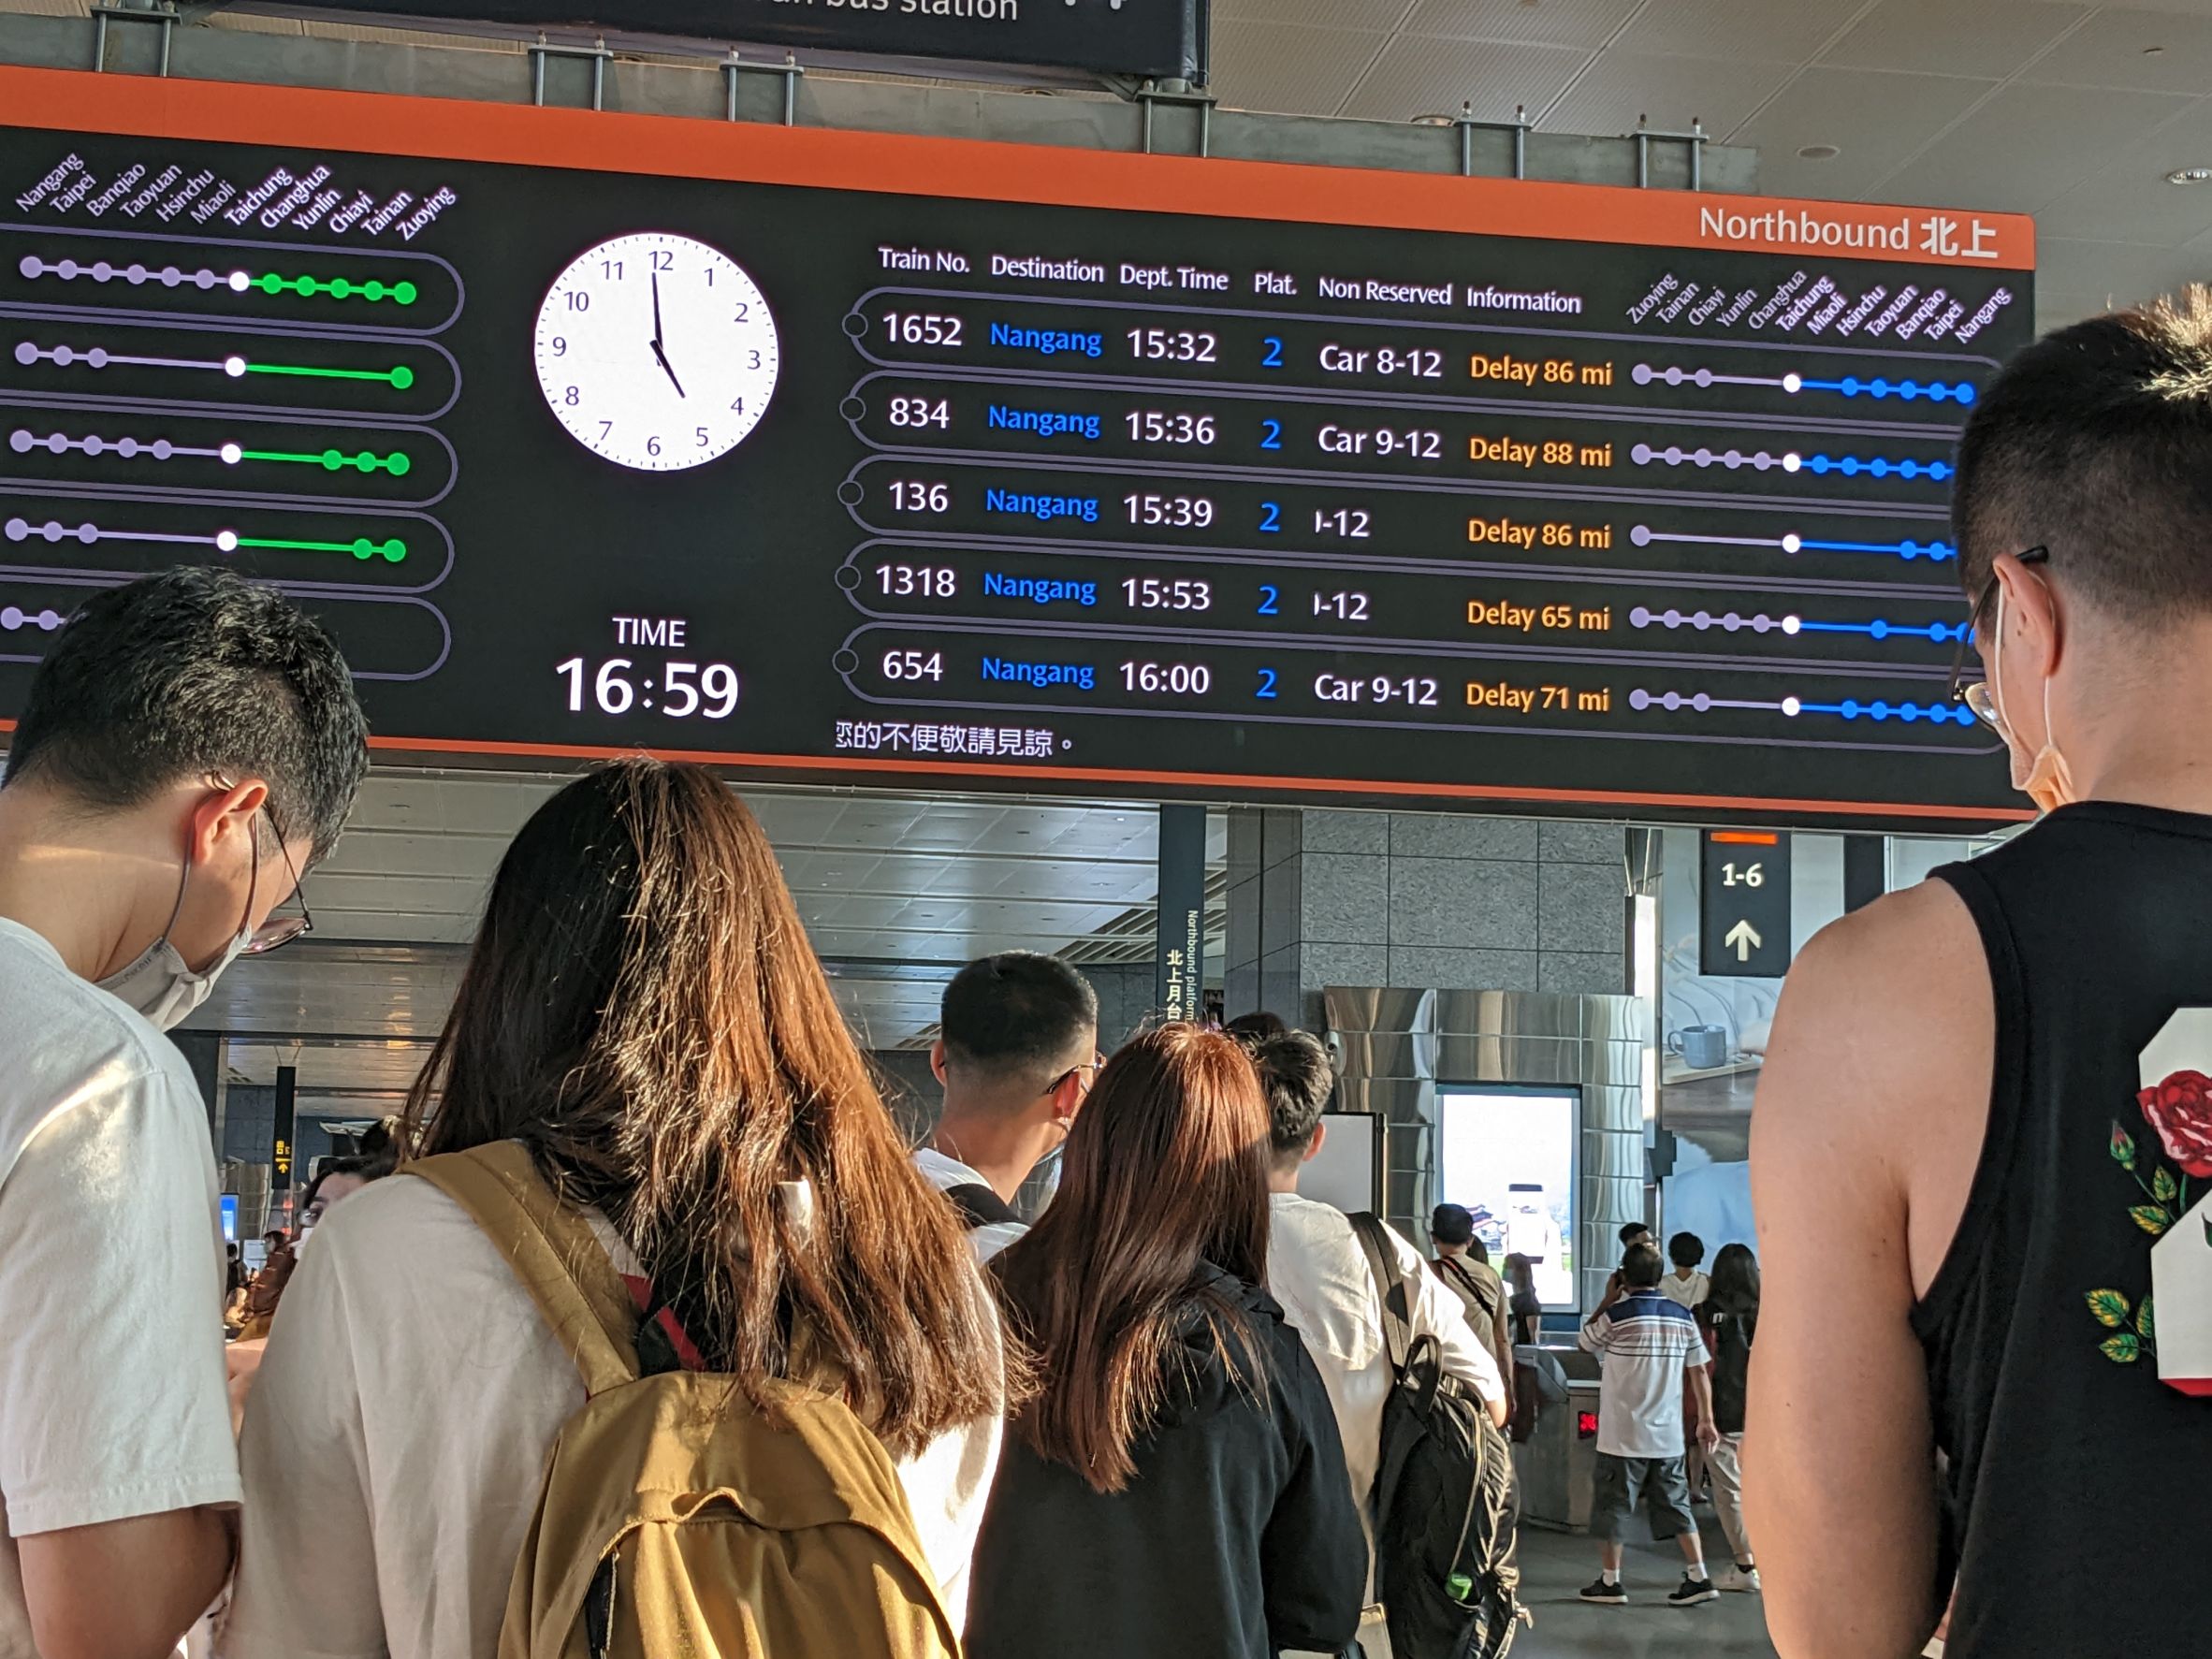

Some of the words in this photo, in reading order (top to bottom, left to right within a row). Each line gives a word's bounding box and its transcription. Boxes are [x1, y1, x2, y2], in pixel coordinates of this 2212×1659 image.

[900, 0, 1018, 21] station
[15, 153, 84, 212] Nangang
[49, 170, 96, 213] Taipei
[86, 164, 147, 217] Banqiao
[119, 164, 183, 218] Taoyuan
[155, 168, 215, 223] Hsinchu
[224, 167, 294, 226] Taichung
[260, 165, 331, 229] Changhua
[190, 179, 237, 225] Miaoli
[291, 188, 342, 231] Yunlin
[329, 189, 374, 234] Chiayi
[360, 191, 414, 236] Tainan
[395, 186, 457, 241] Zuoying
[1700, 207, 1910, 251] Northbound
[1920, 216, 1999, 259] 北上
[602, 261, 622, 280] 11
[650, 252, 673, 270] 12
[879, 247, 930, 270] Train
[937, 252, 969, 272] No.
[992, 255, 1104, 282] Destination
[706, 269, 712, 286] 1
[1121, 265, 1172, 289] Dept.
[1177, 268, 1229, 290] Time
[1255, 272, 1297, 295] Plat.
[1319, 278, 1361, 298] Non
[1366, 281, 1452, 305] Reserved
[565, 292, 589, 311] 10
[735, 303, 748, 322] 2
[1468, 286, 1581, 313] Information
[1625, 273, 1679, 325] Zuoying
[1655, 283, 1700, 324] Tainan
[1688, 285, 1725, 327] Chiayi
[1715, 289, 1757, 327] Yunlin
[1749, 270, 1807, 329] Changhua
[1775, 275, 1835, 331] Taichung
[1807, 291, 1847, 335] Miaoli
[1836, 285, 1886, 337] Hsinchu
[1864, 285, 1917, 337] Taoyuan
[883, 313, 962, 345] 1652
[1895, 289, 1946, 341] Banqiao
[1924, 299, 1964, 341] Taipei
[1955, 287, 2012, 344] Nangang
[553, 337, 566, 357] 9
[991, 323, 1101, 357] Nangang
[1128, 329, 1215, 362] 15:32
[1262, 338, 1282, 366] 2
[749, 351, 760, 369] 3
[1320, 345, 1369, 372] Car
[1377, 349, 1441, 377] 8-12
[1472, 356, 1538, 386] Delay
[1544, 360, 1575, 383] 86
[1582, 362, 1611, 386] mi
[566, 386, 578, 405] 8
[731, 398, 743, 415] 4
[890, 398, 949, 429] 834
[989, 405, 1100, 438] Nangang
[1126, 413, 1215, 444] 15:36
[600, 421, 612, 440] 7
[697, 428, 707, 446] 5
[1260, 419, 1281, 449] 2
[1318, 426, 1367, 453] Car
[1376, 429, 1440, 458] 9-12
[648, 437, 661, 456] 6
[1471, 437, 1536, 467] Delay
[1543, 443, 1573, 464] 88
[1581, 444, 1610, 466] mi
[890, 482, 948, 512] 136
[987, 489, 1098, 521] Nangang
[1124, 495, 1212, 527] 15:39
[1259, 502, 1280, 531] 2
[1469, 518, 1536, 549] Delay
[1542, 524, 1573, 546] 86
[1580, 525, 1610, 548] mi
[877, 565, 955, 597] 1318
[985, 573, 1096, 605] Nangang
[1122, 579, 1210, 610] 15:53
[1258, 586, 1278, 614] 2
[1468, 601, 1535, 632] Delay
[1542, 606, 1572, 628] 65
[1579, 607, 1609, 630] mi
[612, 618, 686, 647] TIME
[883, 651, 942, 681] 654
[982, 658, 1095, 689] Nangang
[1120, 662, 1209, 693] 16:00
[557, 658, 737, 718] 16:59
[1257, 669, 1276, 697] 2
[1315, 675, 1364, 701] Car
[1373, 677, 1437, 706] 9-12
[1467, 683, 1535, 712] Delay
[1541, 687, 1568, 709] 71
[1579, 688, 1608, 711] mi
[1722, 863, 1763, 887] 1-6
[1186, 910, 1199, 973] Northbound
[1166, 949, 1184, 1021] 北上月台
